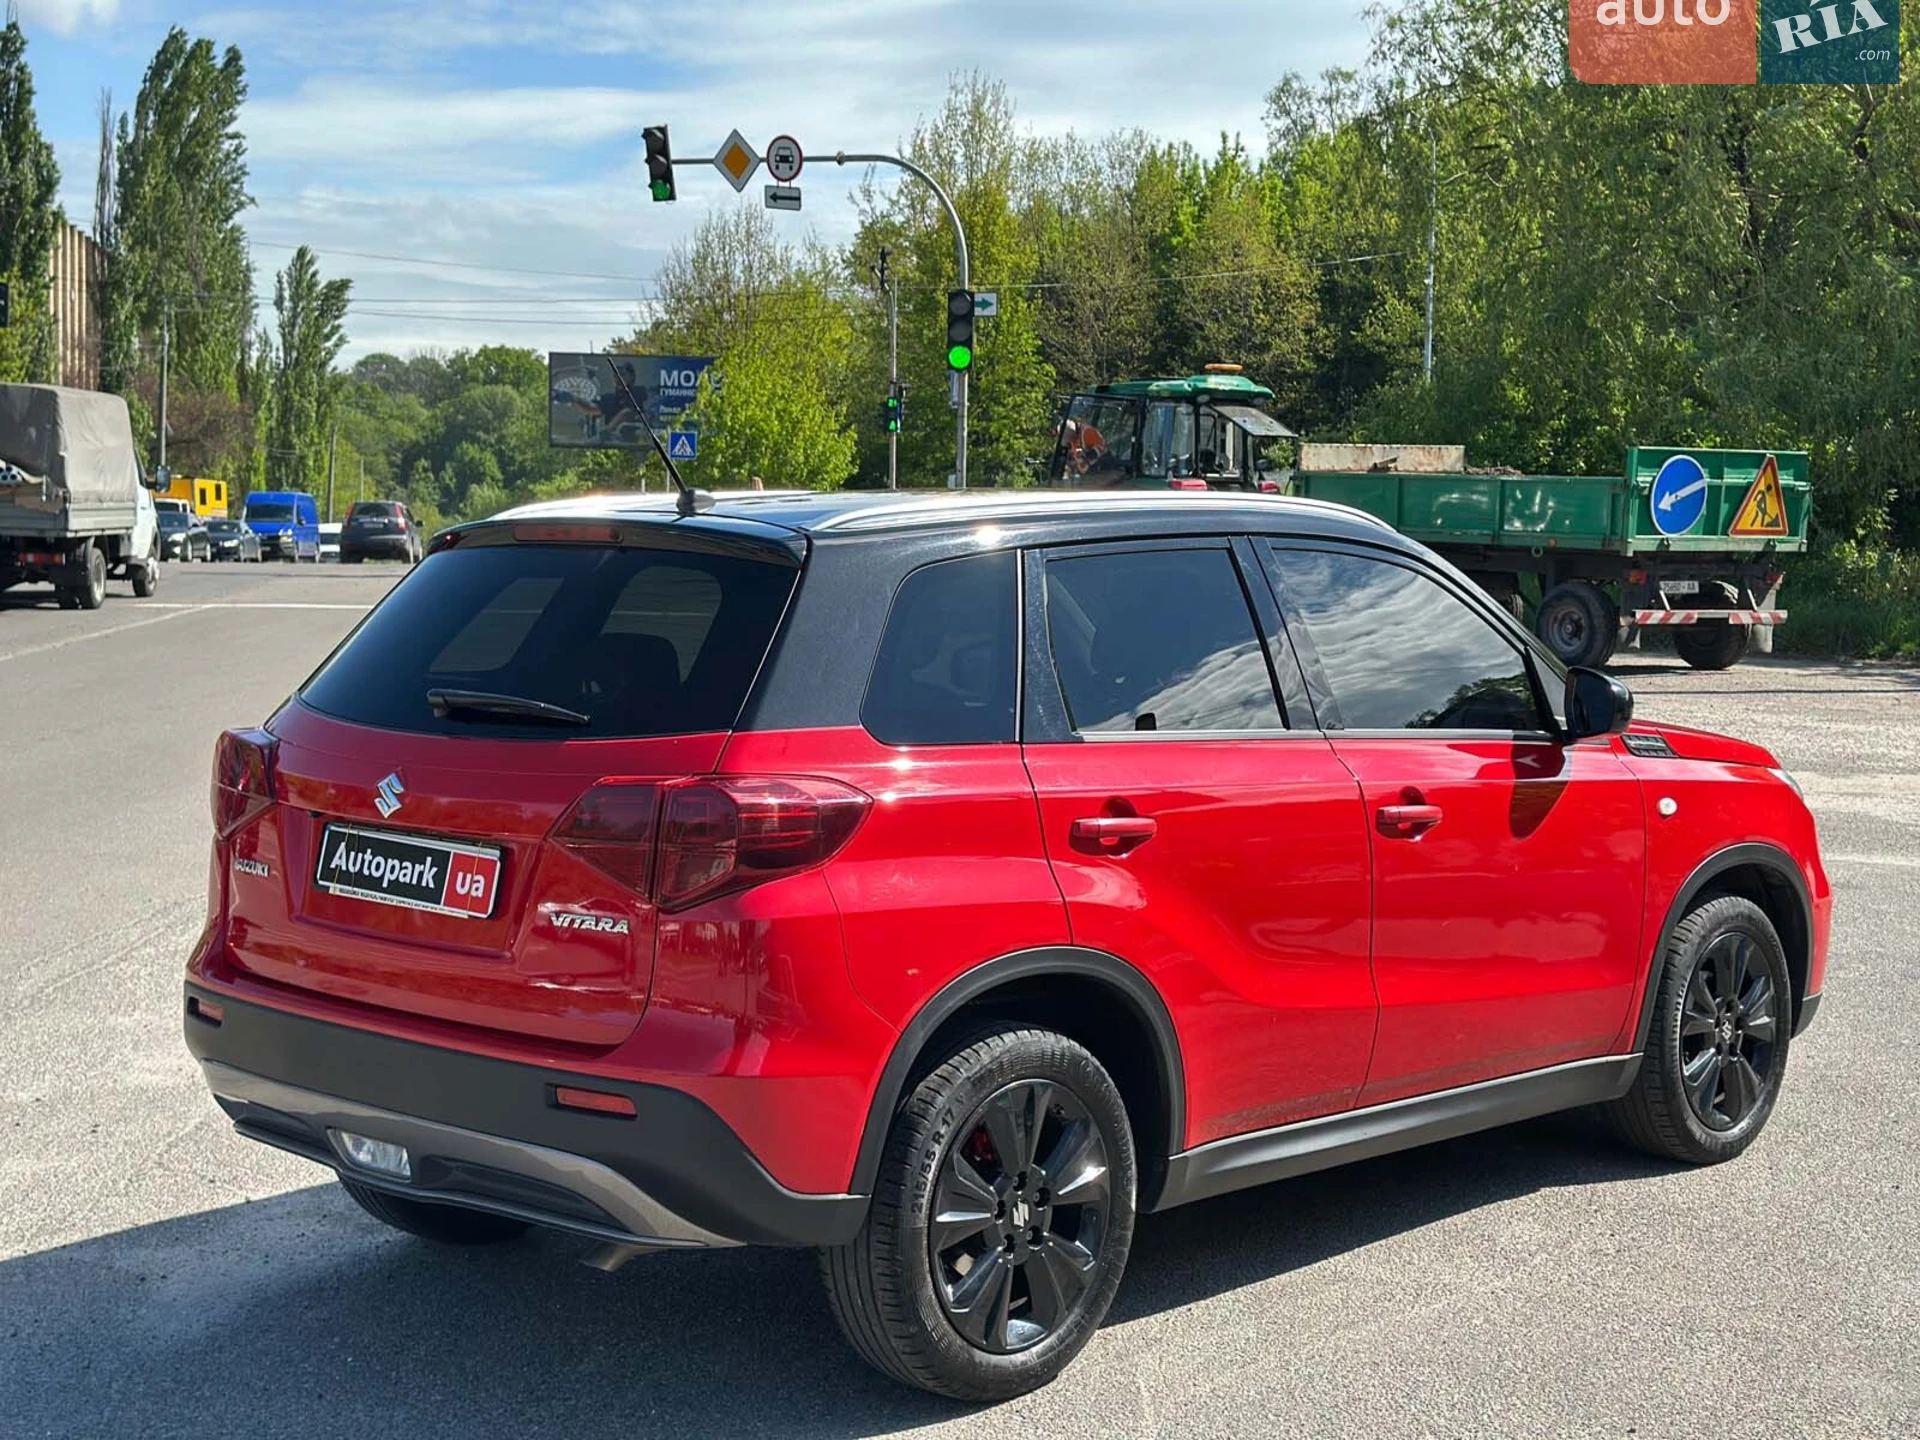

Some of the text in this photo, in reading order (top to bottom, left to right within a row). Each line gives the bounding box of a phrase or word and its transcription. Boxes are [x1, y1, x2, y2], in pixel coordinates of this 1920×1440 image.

[234, 858, 269, 878] SUZUKI
[329, 841, 485, 898] Autopark ua
[549, 911, 630, 935] VITARA
[911, 1105, 955, 1214] 215/55 R 17
